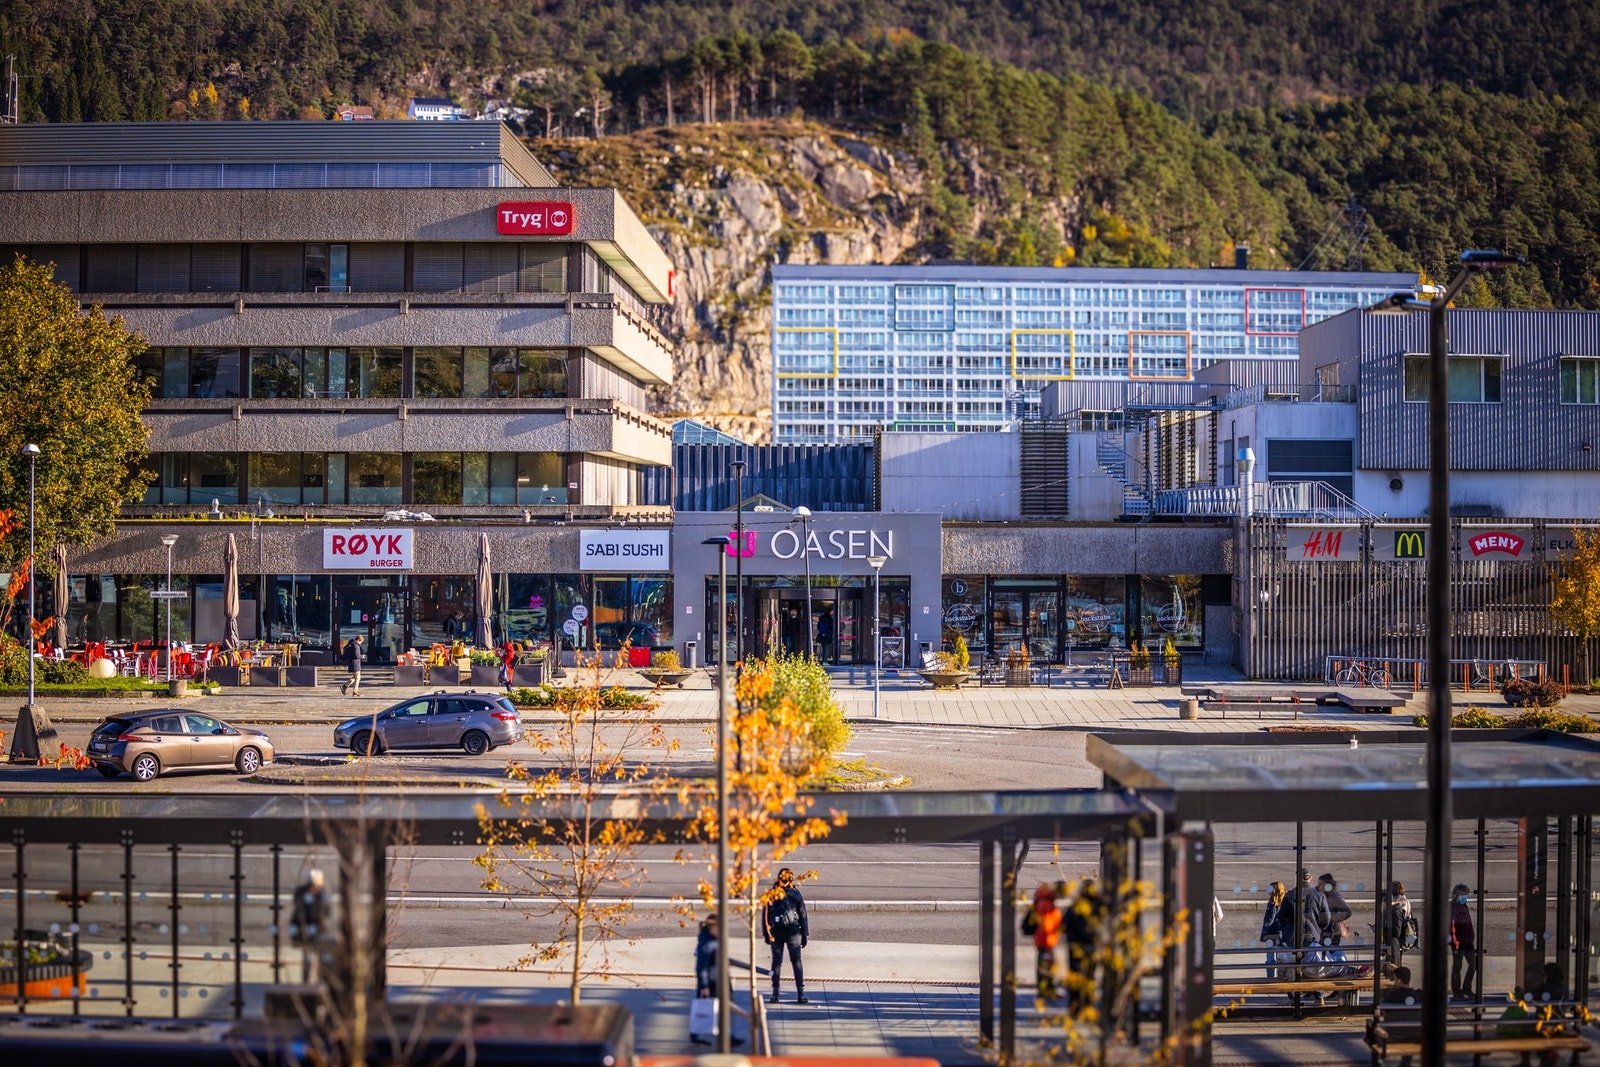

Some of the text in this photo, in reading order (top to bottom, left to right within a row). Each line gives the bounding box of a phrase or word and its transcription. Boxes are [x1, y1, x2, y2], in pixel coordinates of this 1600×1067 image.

[501, 210, 542, 229] Tryg
[331, 534, 403, 555] RØYK
[586, 543, 663, 556] SABI SUSHI
[770, 529, 893, 559] OASEN
[1303, 531, 1343, 558] H&M
[1474, 536, 1519, 551] MENY
[370, 559, 403, 568] BURGER
[1080, 614, 1112, 622] backstube
